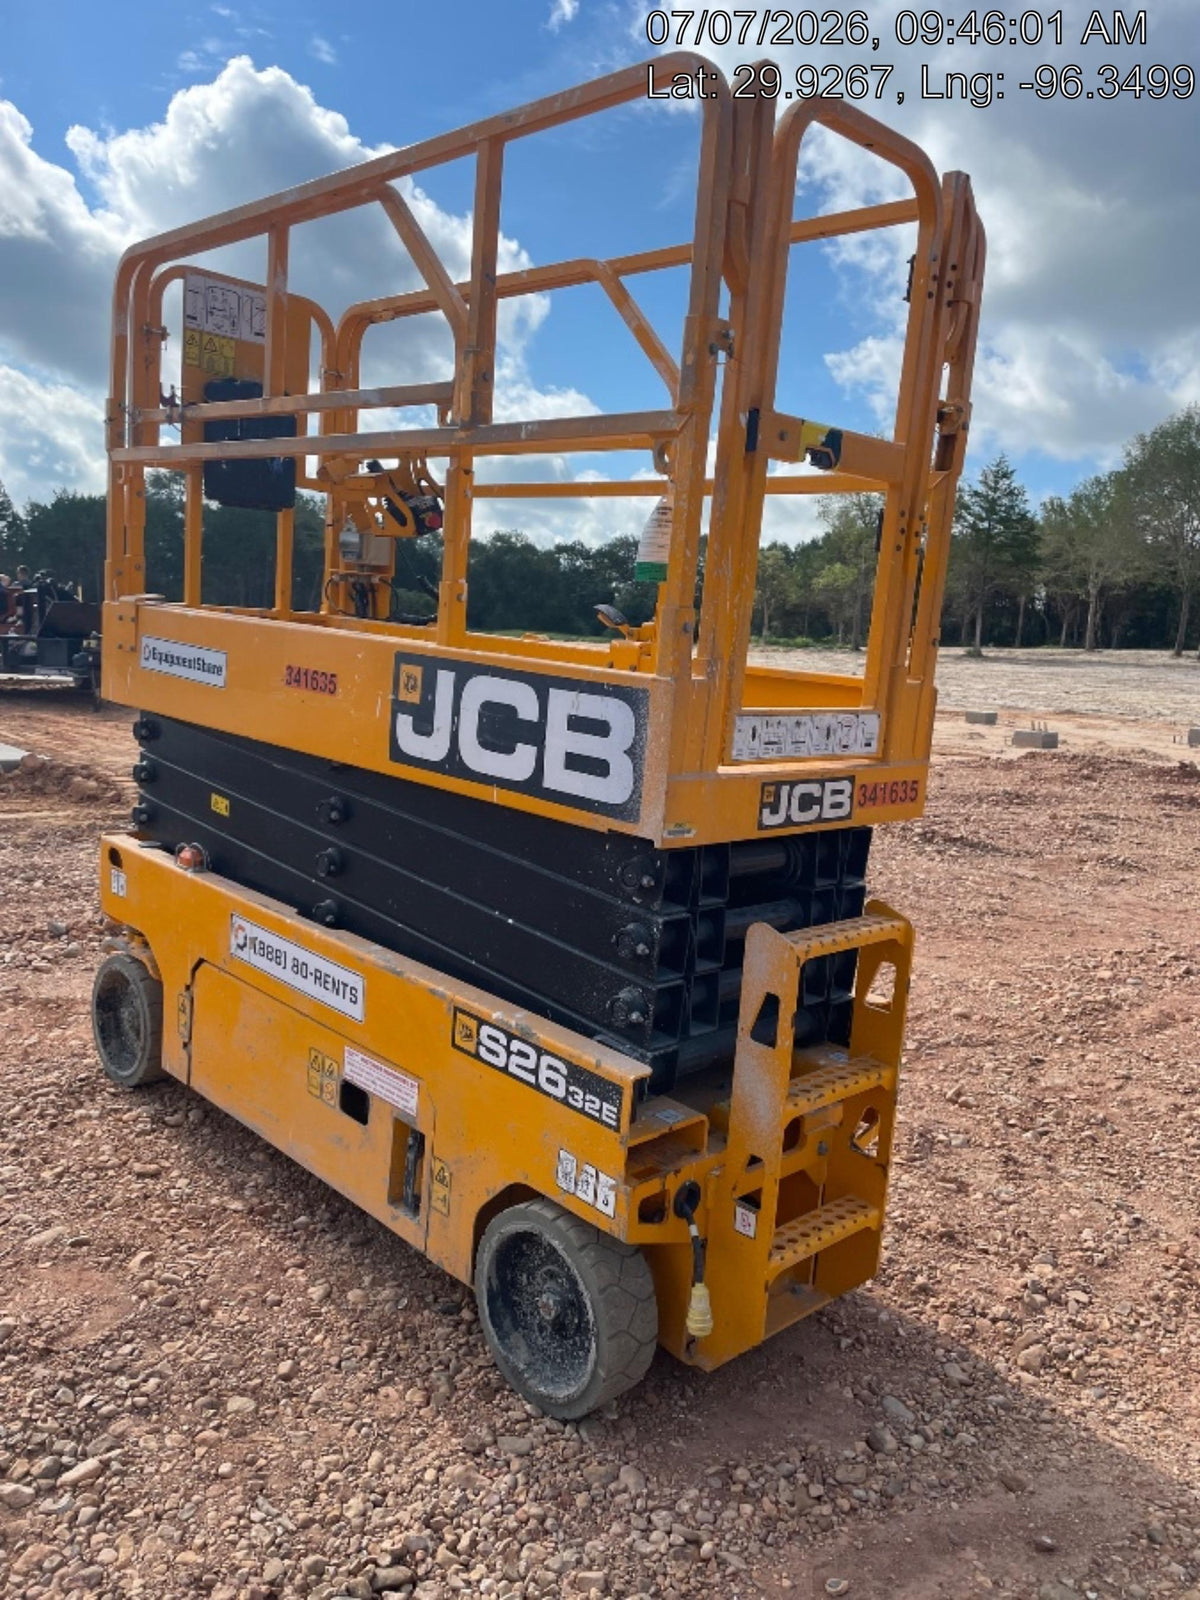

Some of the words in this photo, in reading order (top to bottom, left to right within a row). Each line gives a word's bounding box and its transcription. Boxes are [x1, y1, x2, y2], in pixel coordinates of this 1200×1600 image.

[284, 664, 338, 695] 341635
[396, 668, 637, 805] JCB
[761, 780, 853, 826] JCB
[857, 780, 919, 808] 341635
[291, 957, 359, 1006] 80-RENTS
[477, 1024, 569, 1099] S26
[568, 1086, 618, 1127] 32E
